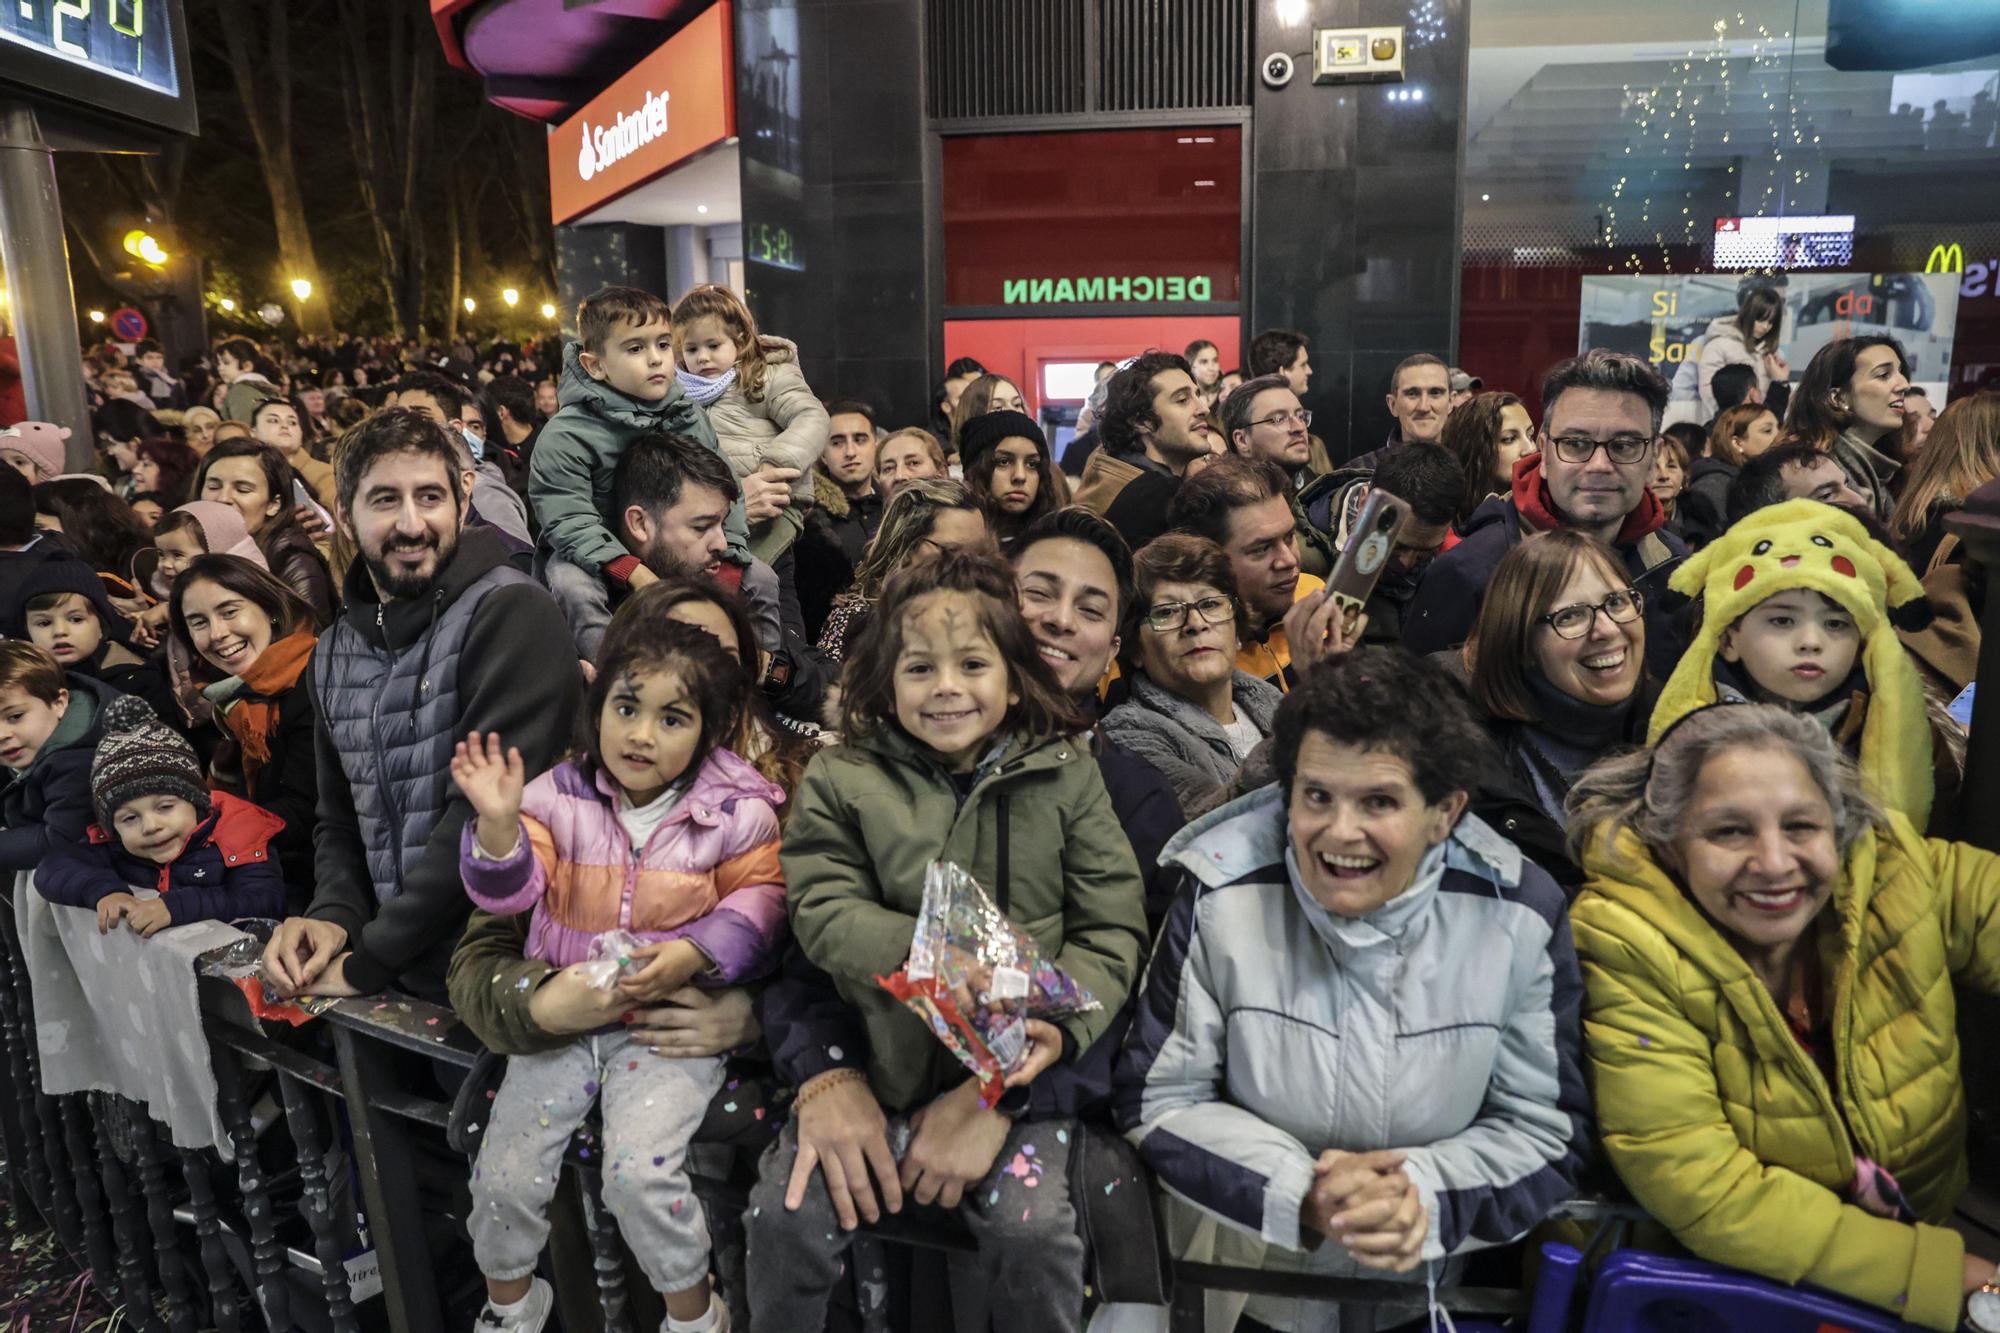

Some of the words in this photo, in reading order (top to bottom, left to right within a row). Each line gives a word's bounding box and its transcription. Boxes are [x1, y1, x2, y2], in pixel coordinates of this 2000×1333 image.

[594, 91, 669, 172] Santander
[1651, 291, 1678, 317] Si
[1835, 290, 1873, 315] da
